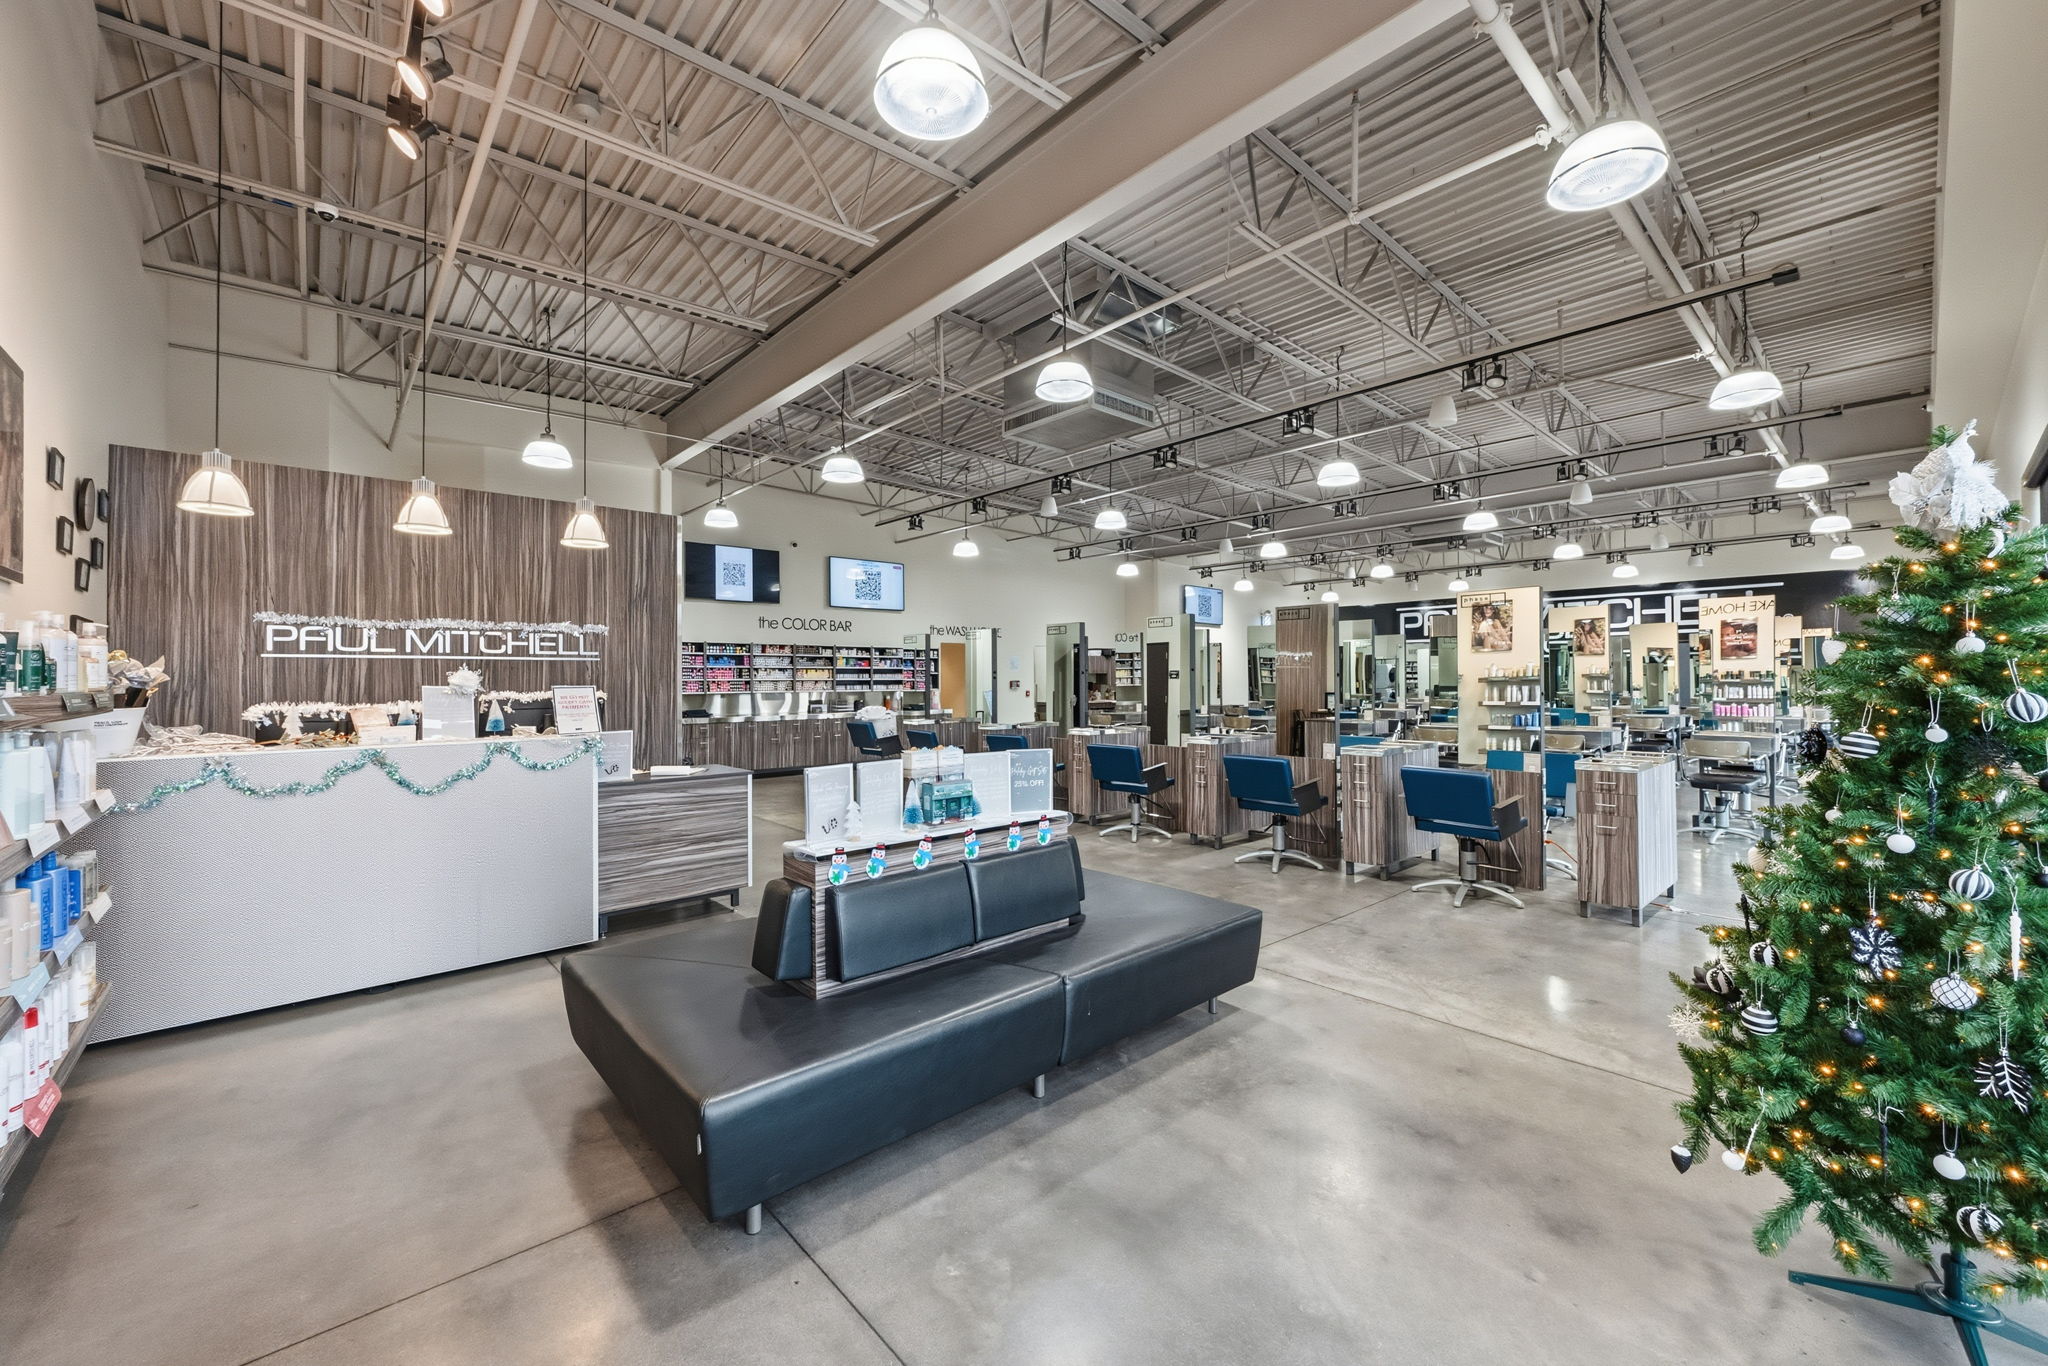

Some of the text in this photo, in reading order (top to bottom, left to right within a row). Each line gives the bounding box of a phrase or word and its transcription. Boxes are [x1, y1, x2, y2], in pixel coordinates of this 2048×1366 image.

[758, 616, 852, 632] the COLOR BAR
[929, 625, 945, 636] the
[266, 624, 600, 656] PAUL MITCHELL
